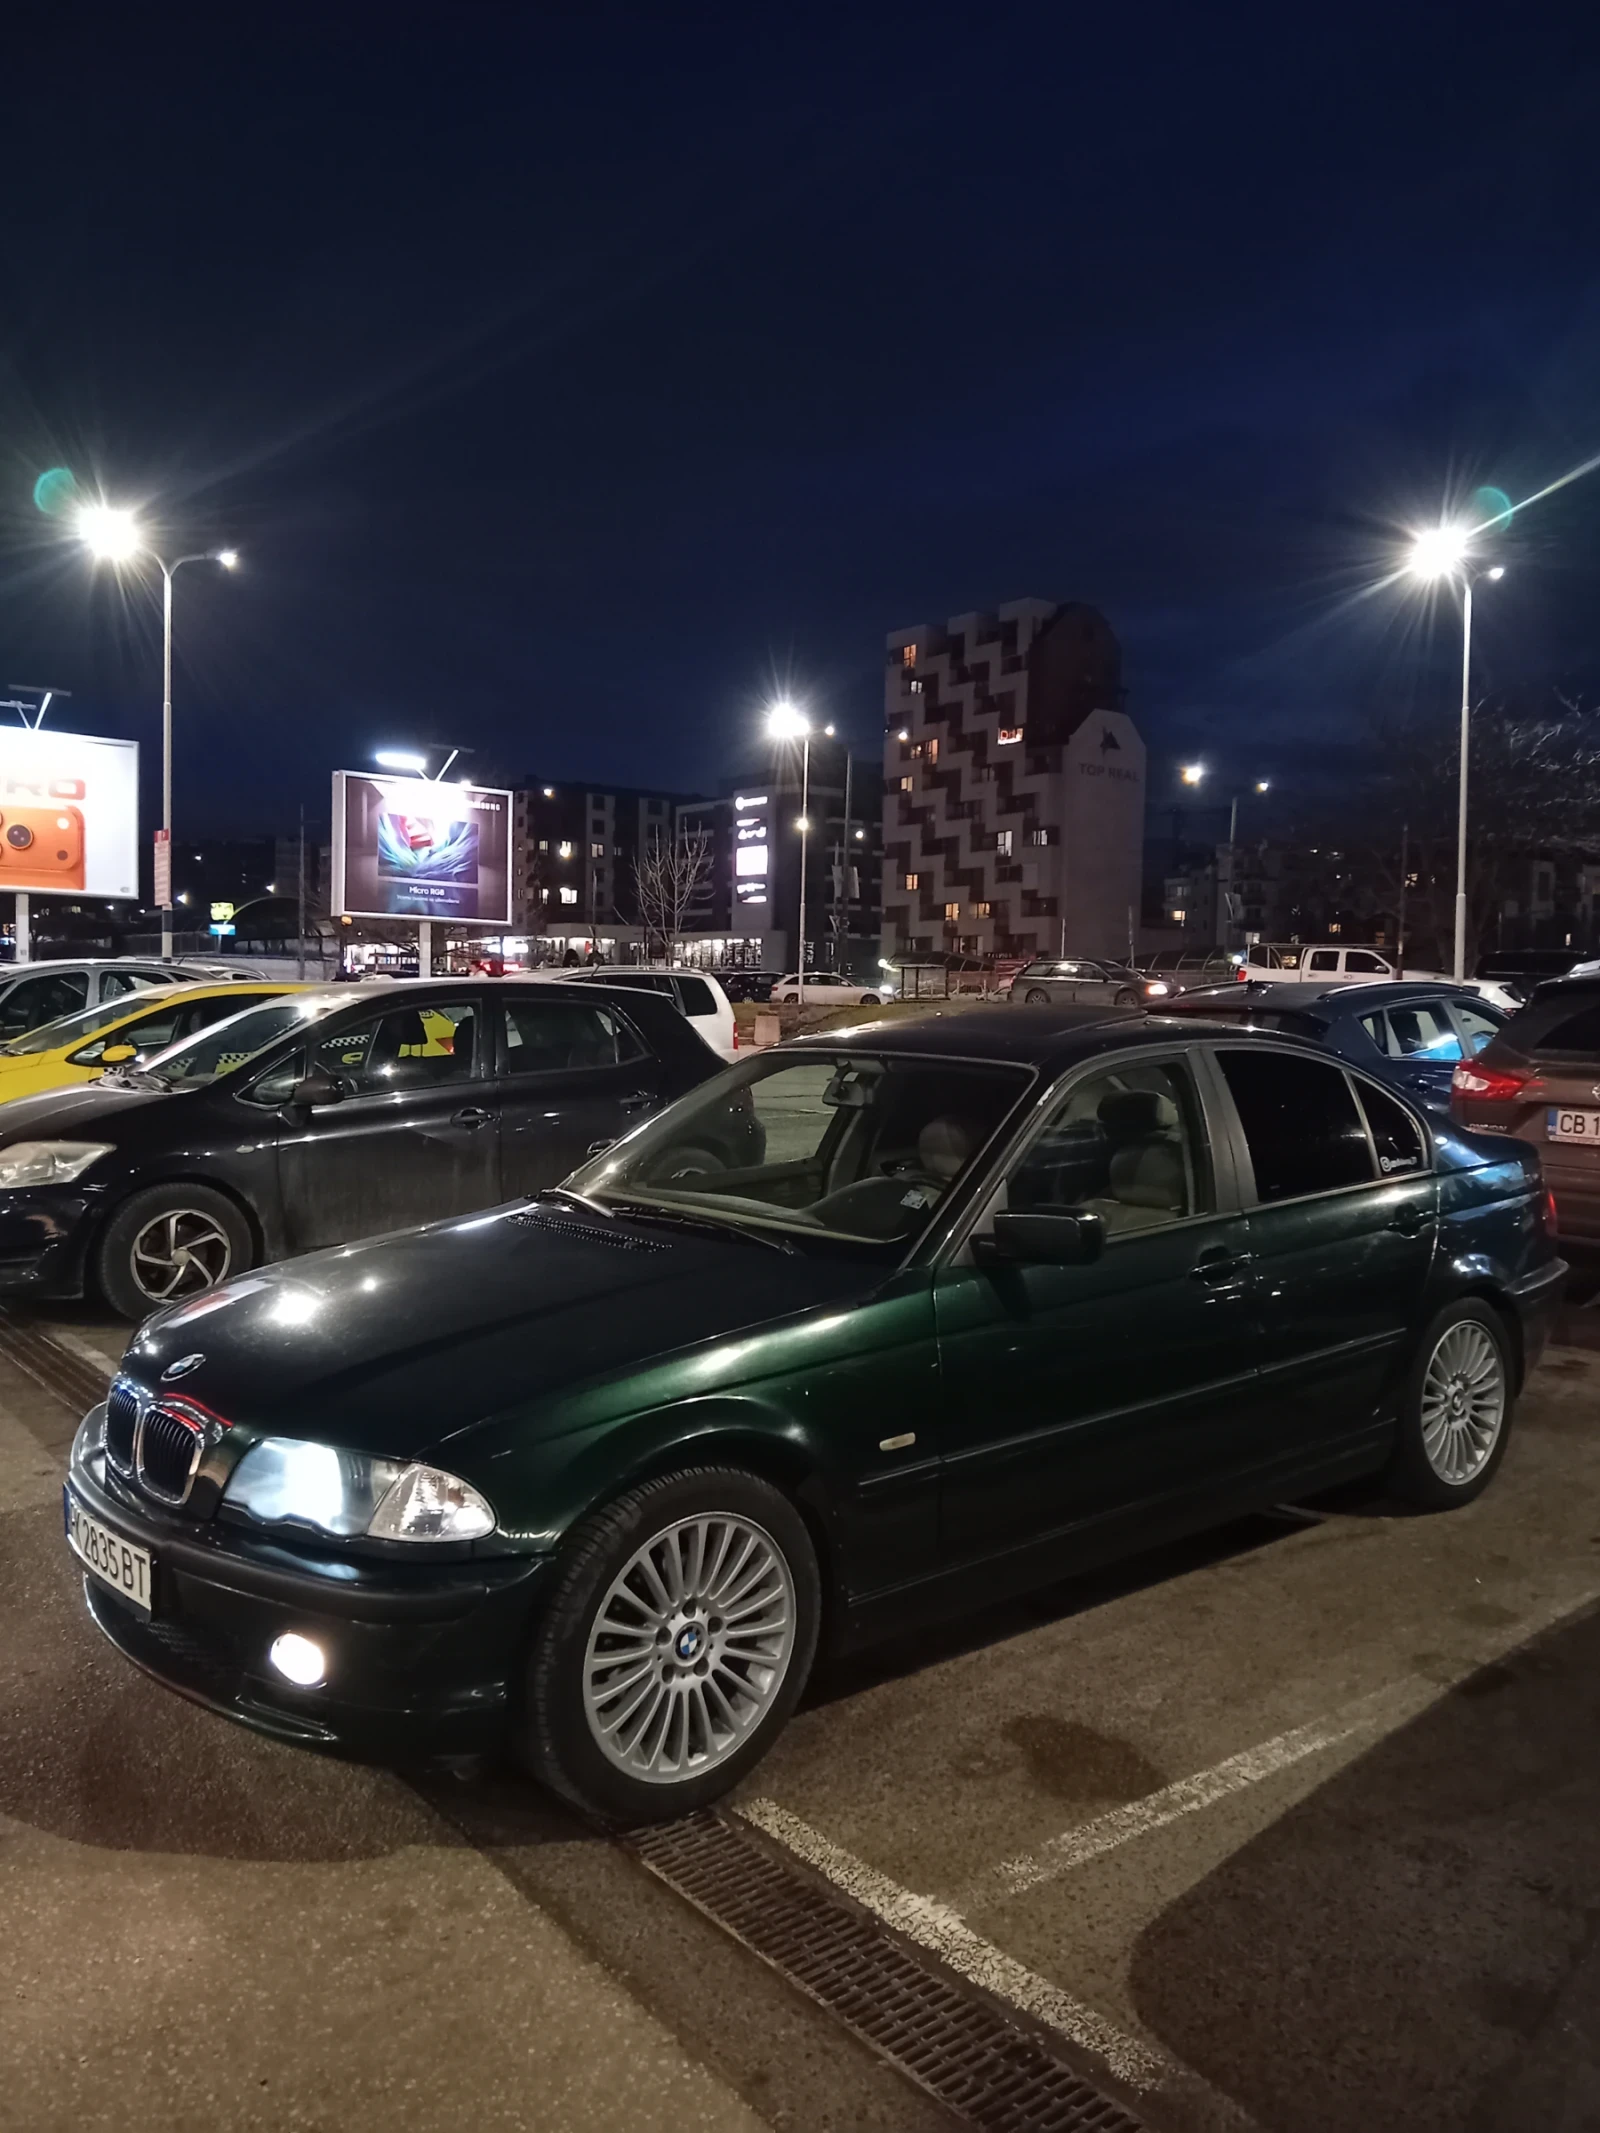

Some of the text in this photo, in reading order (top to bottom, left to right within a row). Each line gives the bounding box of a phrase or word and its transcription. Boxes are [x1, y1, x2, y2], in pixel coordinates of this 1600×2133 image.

[1079, 763, 1140, 783] TOP REAL
[2, 778, 87, 800] RO
[409, 886, 445, 896] Micro RGB
[1560, 1114, 1586, 1134] CB
[83, 1519, 119, 1581] 2835
[121, 1547, 147, 1598] BT
